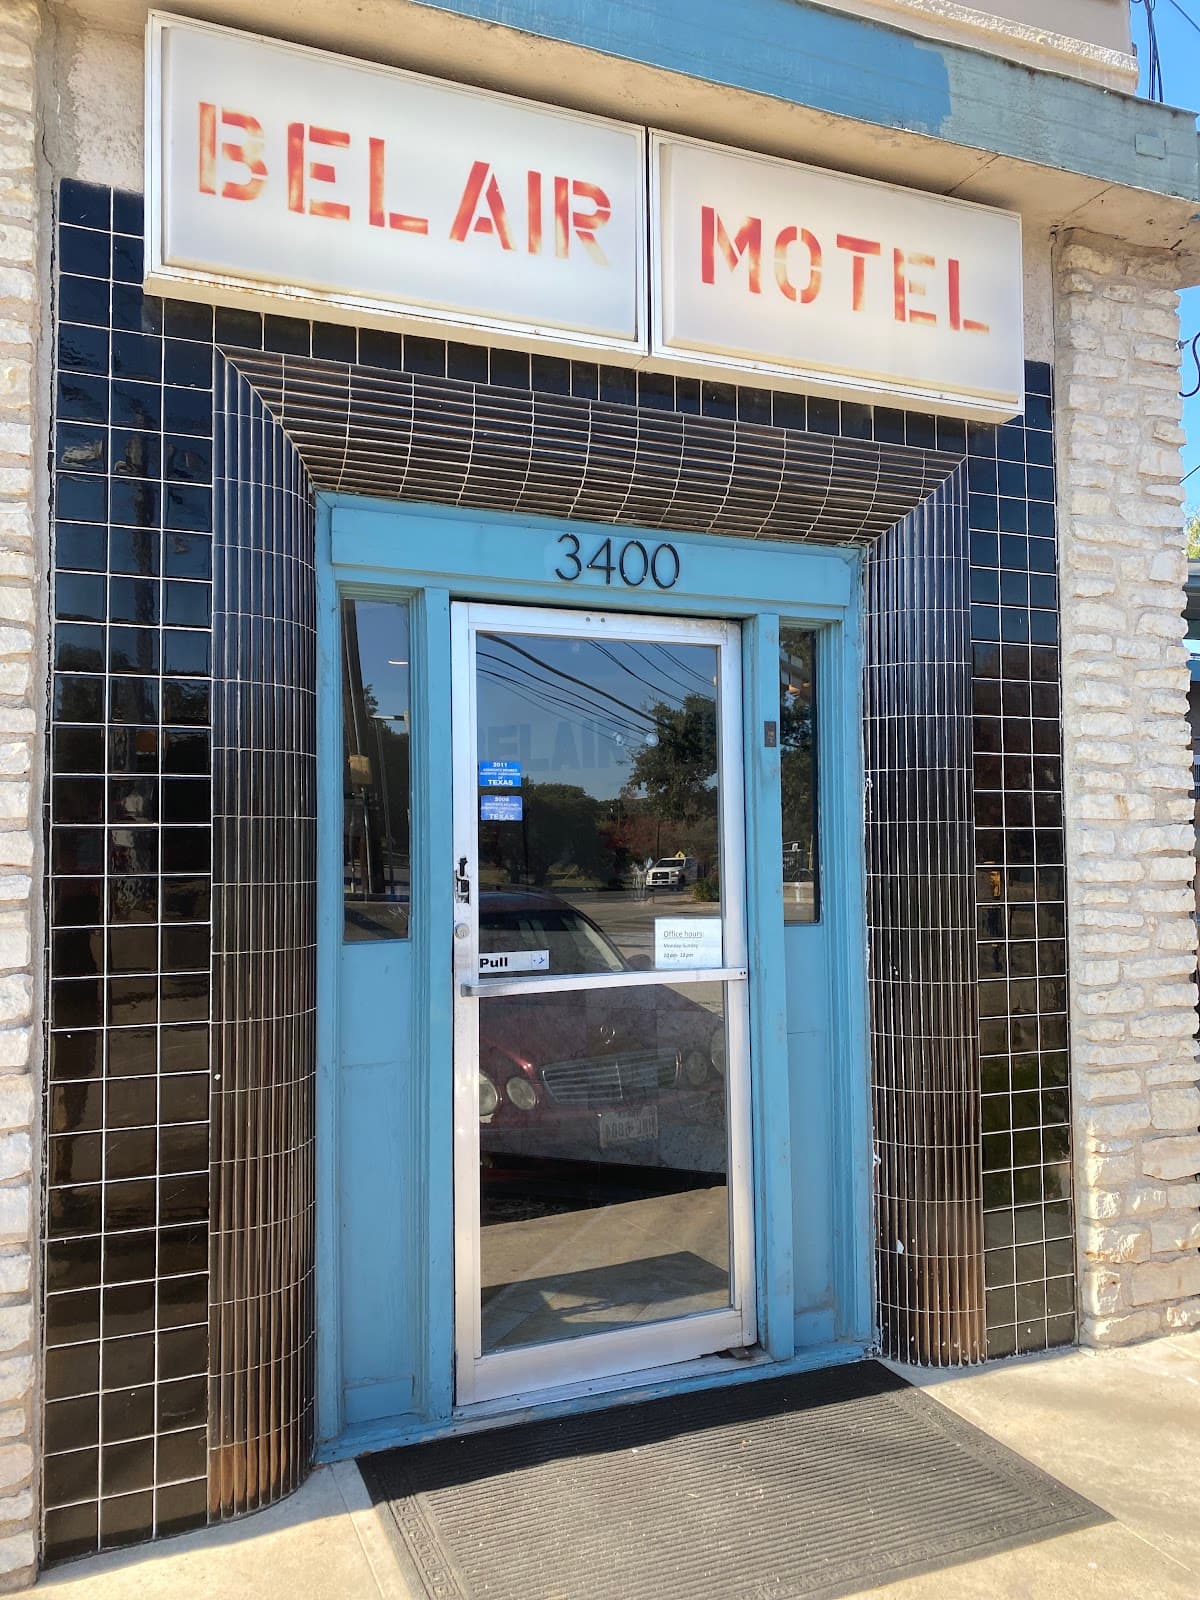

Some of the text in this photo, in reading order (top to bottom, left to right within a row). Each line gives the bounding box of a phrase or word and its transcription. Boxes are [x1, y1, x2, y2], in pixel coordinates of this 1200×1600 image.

[198, 100, 611, 266] BELAIR
[701, 205, 991, 335] MOTEL
[555, 532, 680, 590] 3400
[480, 957, 508, 969] Pull
[664, 930, 682, 938] Office
